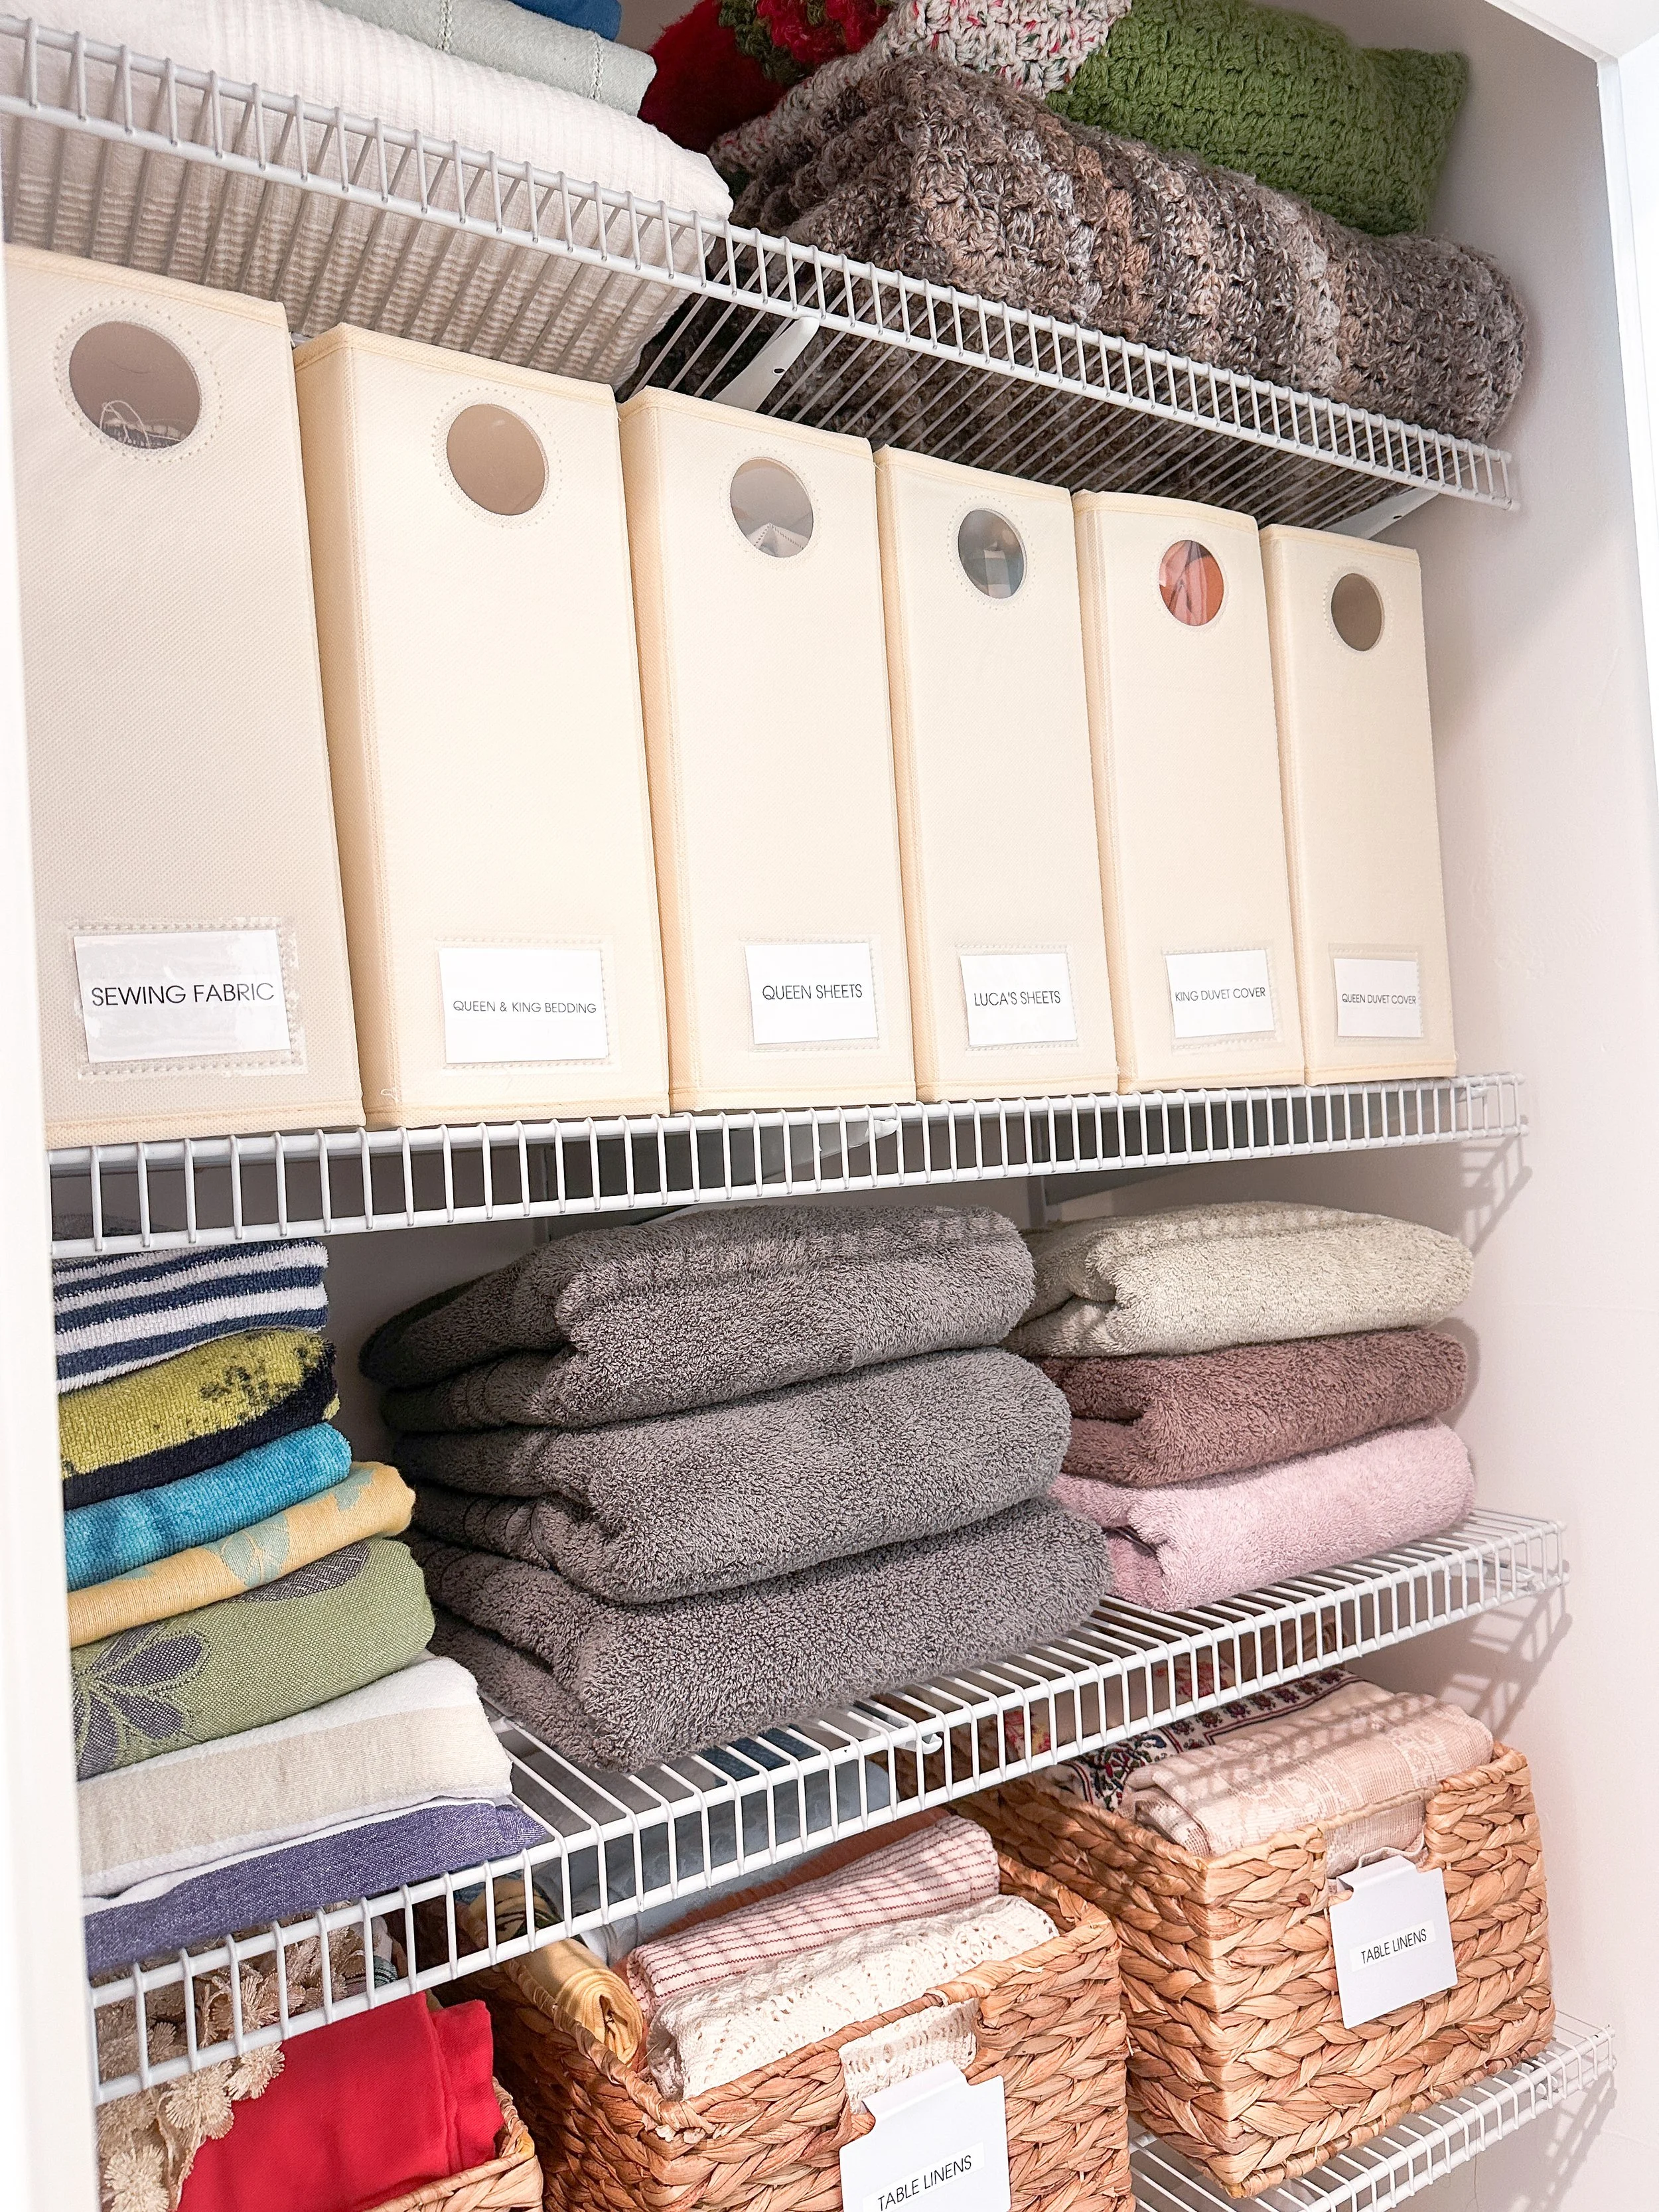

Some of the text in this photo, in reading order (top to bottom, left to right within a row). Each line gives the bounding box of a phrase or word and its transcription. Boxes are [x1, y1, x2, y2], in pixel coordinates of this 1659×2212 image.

[91, 982, 274, 1007] SEWING FABRIC
[762, 984, 863, 1000] QUEEN SHEETS
[974, 990, 1061, 1006] LUCA'S SHEETS
[1175, 987, 1266, 1001] KING DUVET COVER
[1341, 993, 1417, 1004] QUEEN DUVET COVER
[453, 1000, 597, 1013] QUEEN & KING BEDDING
[1360, 1928, 1427, 1964] TABLE LINENS
[877, 2154, 972, 2212] TABLE LINENS
